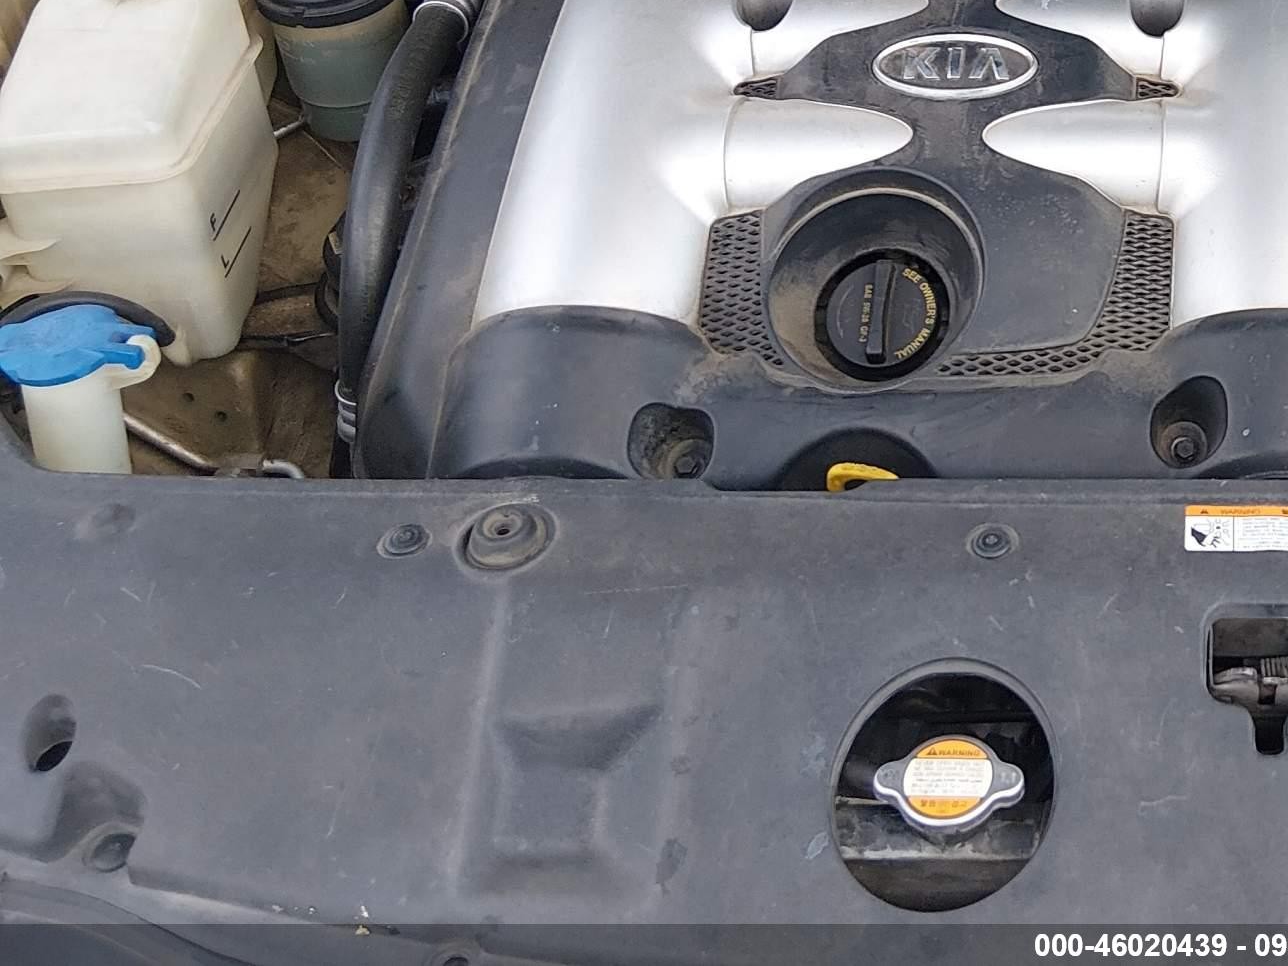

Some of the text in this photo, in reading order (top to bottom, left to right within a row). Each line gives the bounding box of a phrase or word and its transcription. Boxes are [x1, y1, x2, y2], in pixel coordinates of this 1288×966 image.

[903, 46, 1010, 80] KIA
[209, 213, 217, 232] F
[220, 254, 230, 269] L
[894, 268, 937, 359] SEE OWNER'S MANUAL
[938, 748, 981, 756] WARNING
